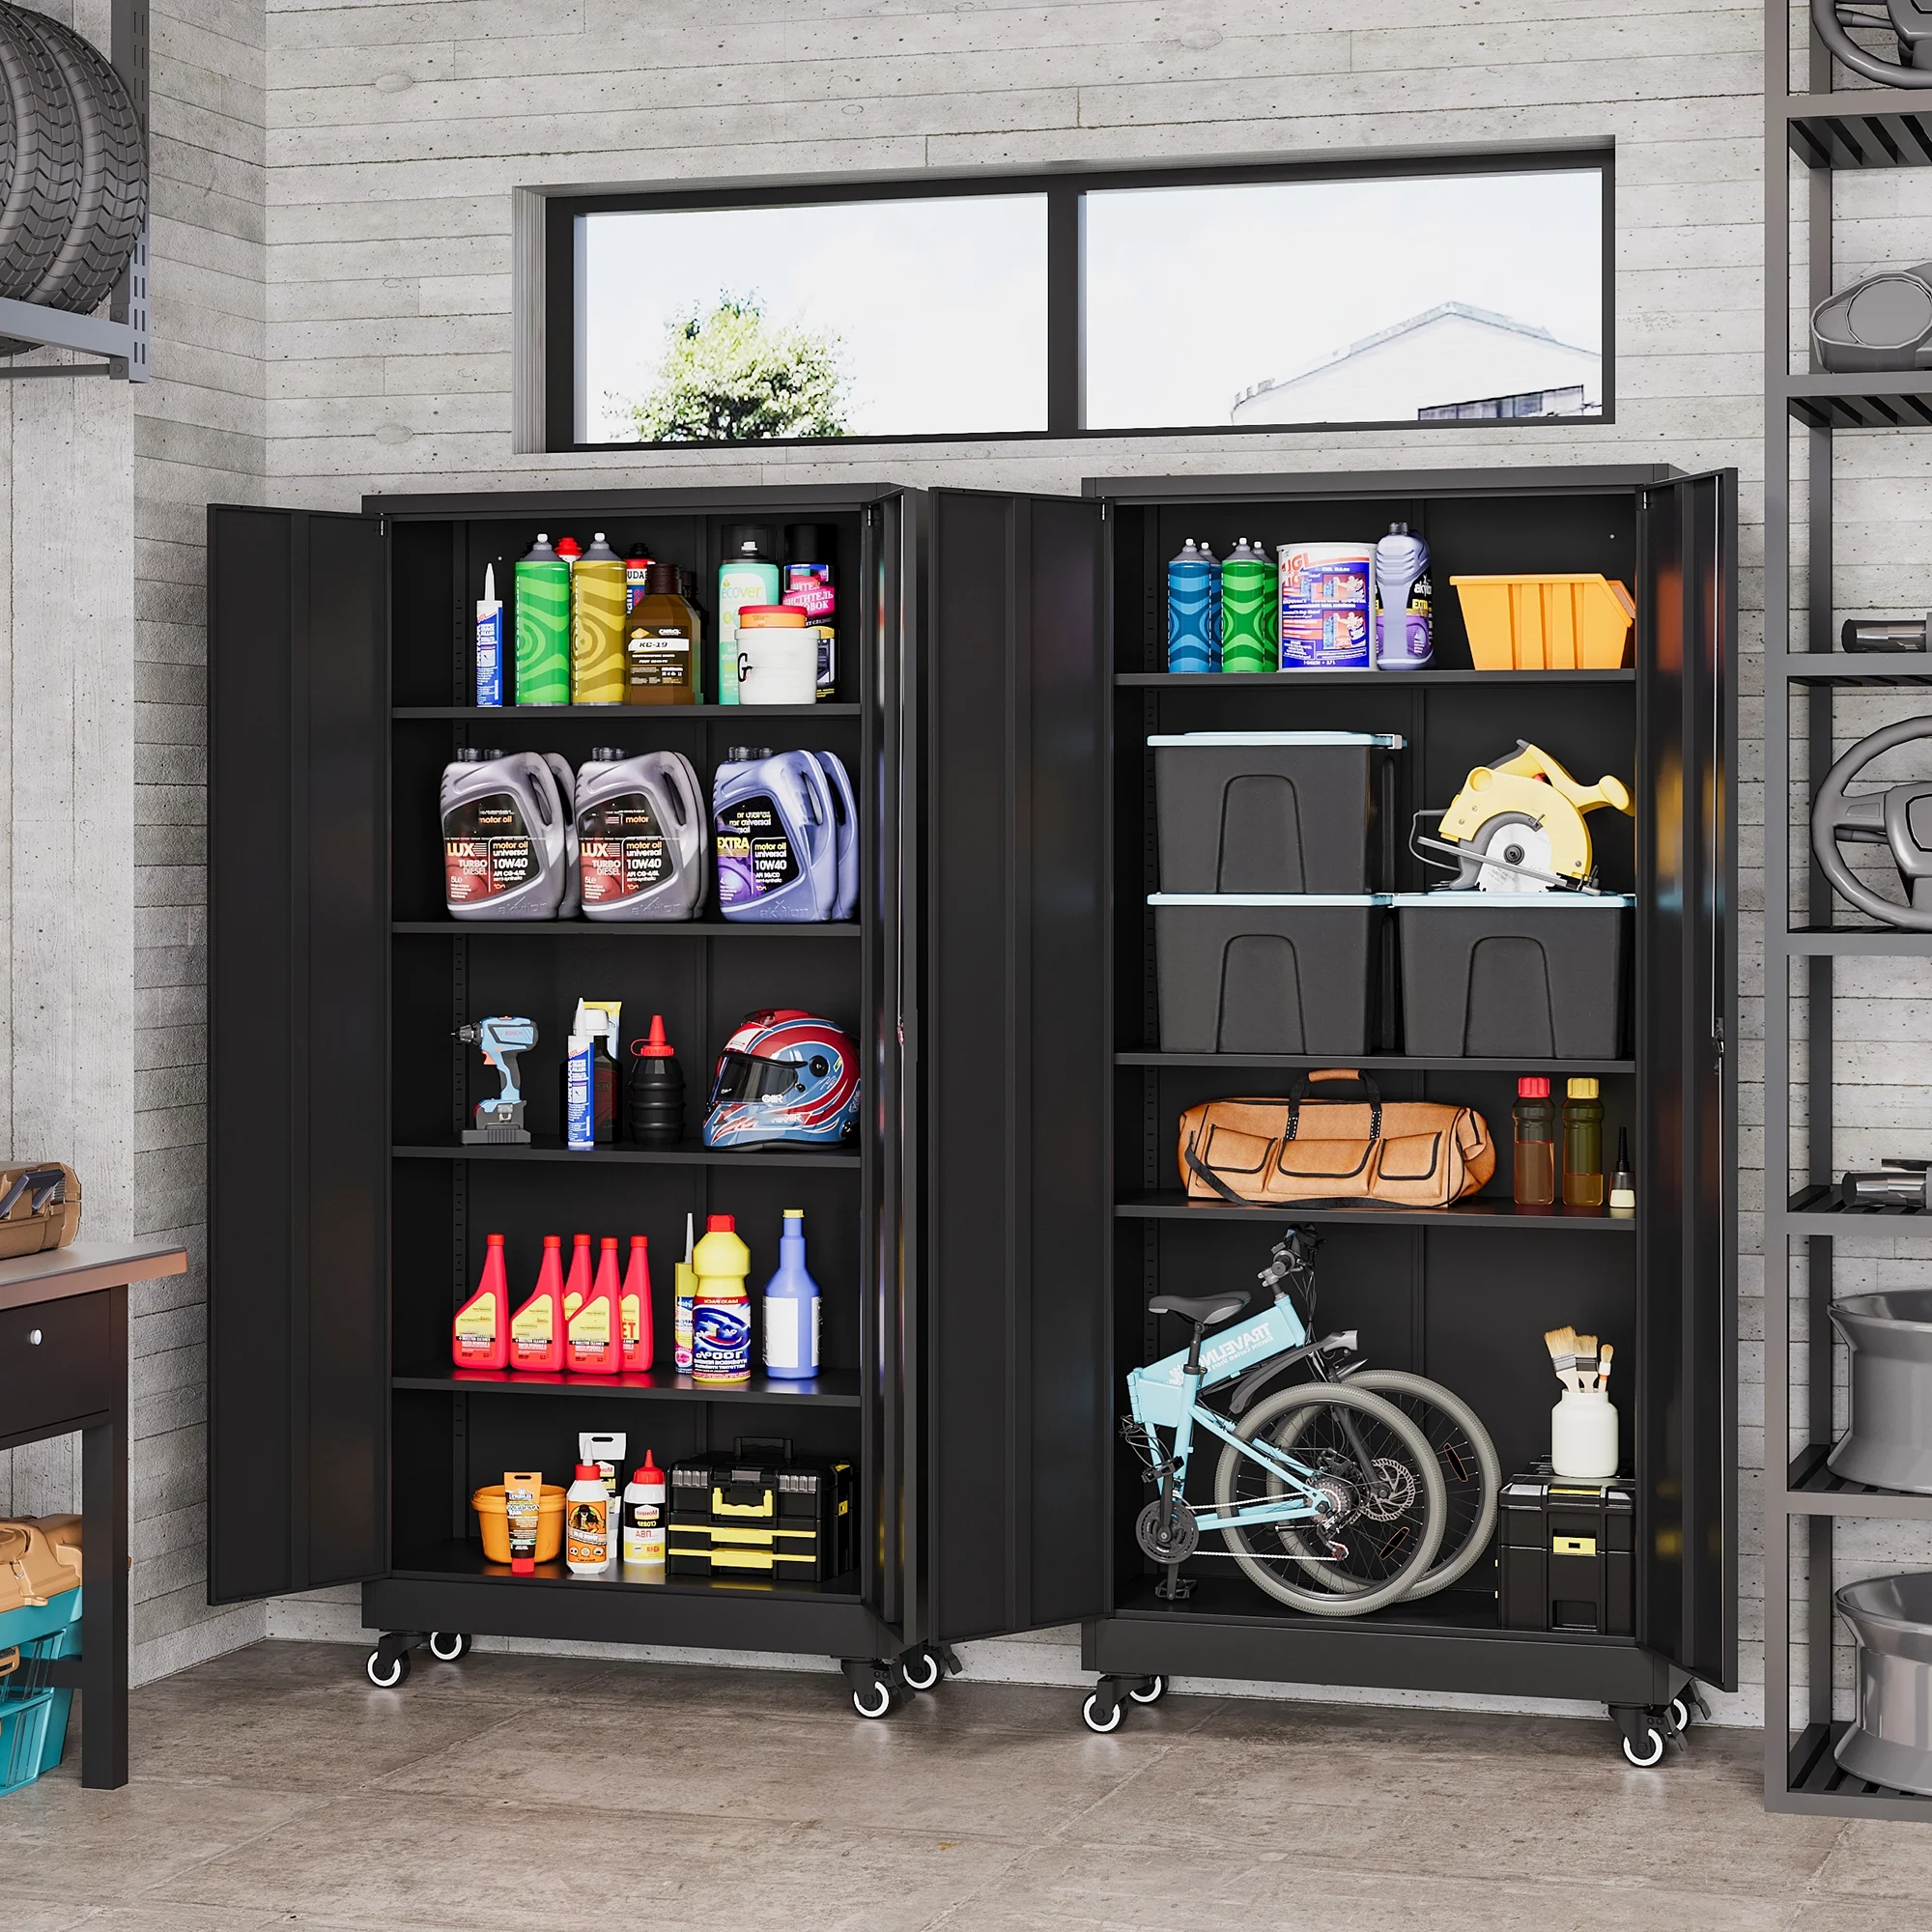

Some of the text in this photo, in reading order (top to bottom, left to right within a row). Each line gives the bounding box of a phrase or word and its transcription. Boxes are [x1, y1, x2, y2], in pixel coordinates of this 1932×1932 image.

[722, 586, 763, 598] ecover
[518, 840, 528, 849] oil
[651, 840, 663, 849] oil
[717, 837, 750, 849] EXTRA
[446, 842, 474, 857] LUX
[493, 848, 528, 857] universal
[581, 842, 609, 857] LUX
[626, 848, 663, 857] universal
[493, 858, 528, 869] 10W40
[592, 860, 621, 868] TURBO
[626, 858, 662, 869] 10W40
[754, 860, 787, 870] 10W40
